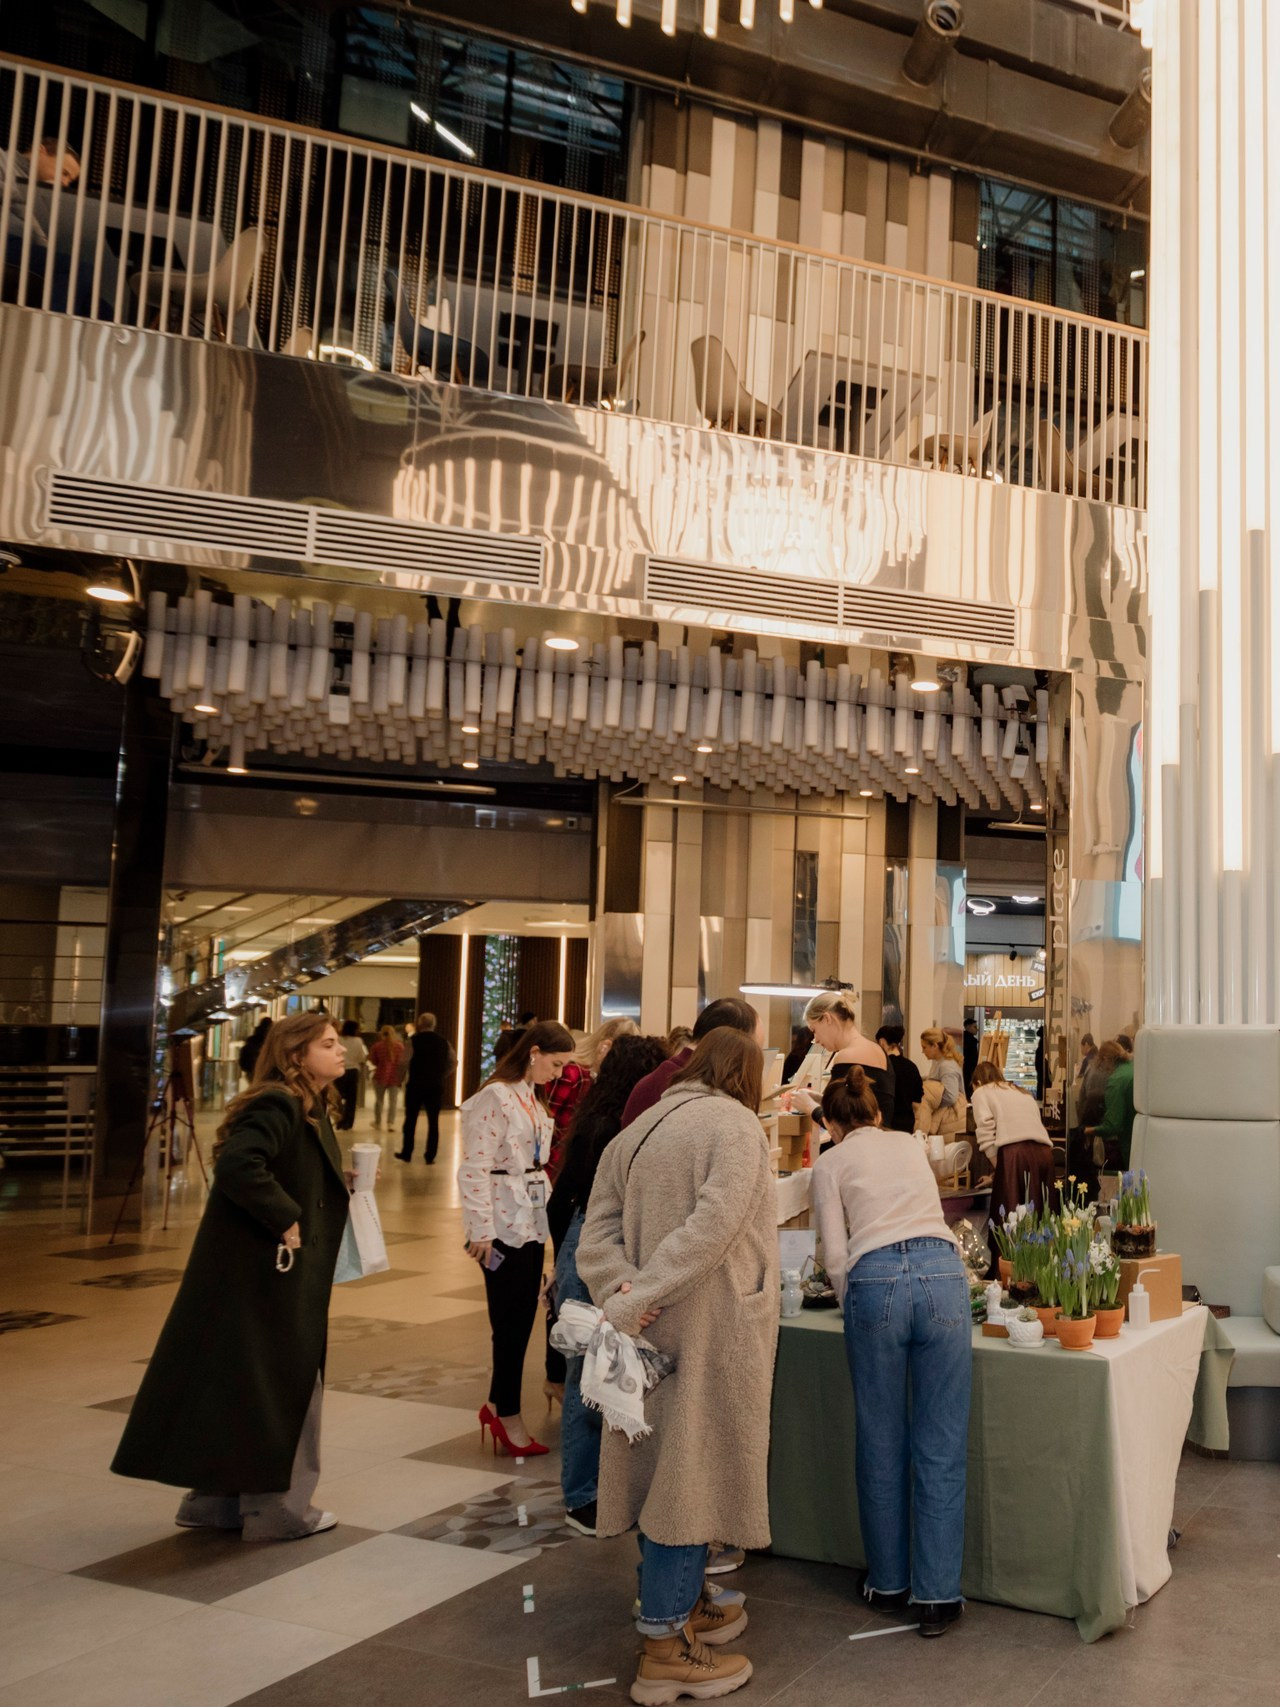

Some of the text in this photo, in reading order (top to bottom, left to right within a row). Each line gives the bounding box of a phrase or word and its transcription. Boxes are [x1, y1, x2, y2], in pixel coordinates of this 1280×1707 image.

[1050, 849, 1067, 948] place
[963, 971, 1036, 988] ЫЙ ДЕНЬ
